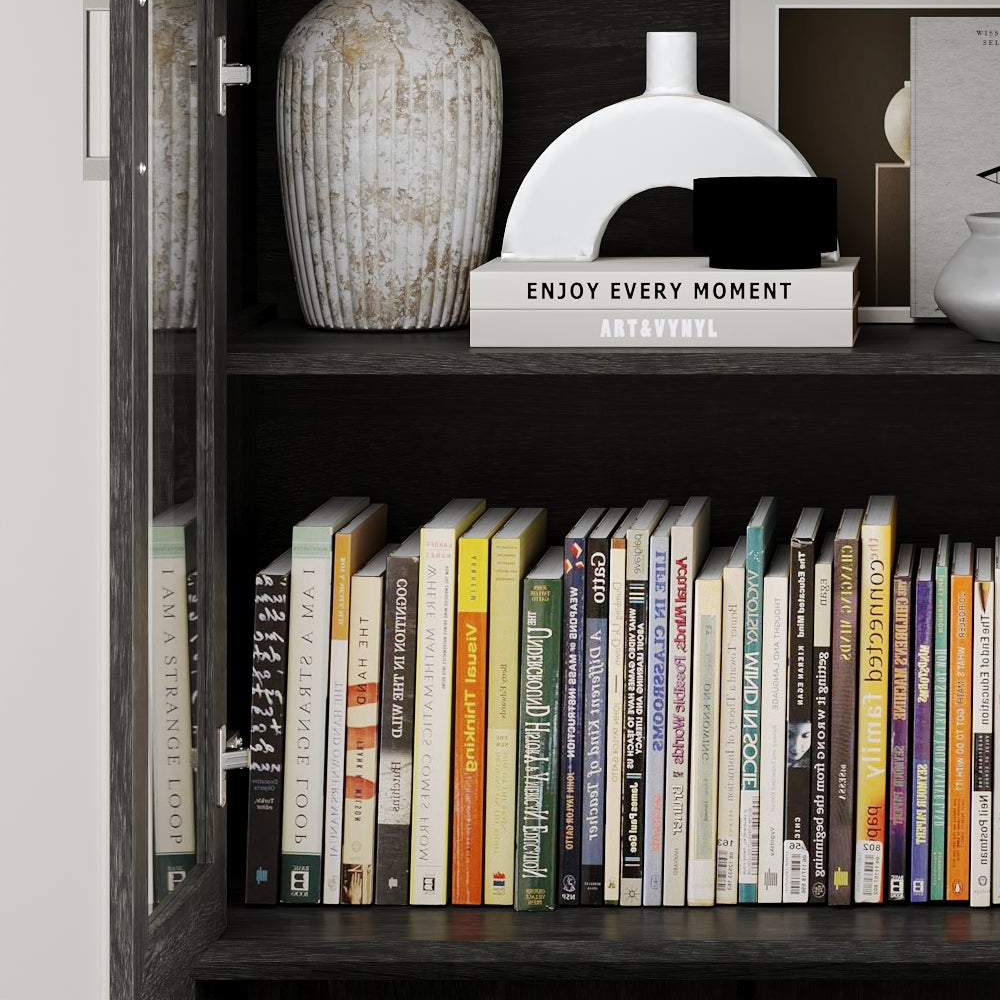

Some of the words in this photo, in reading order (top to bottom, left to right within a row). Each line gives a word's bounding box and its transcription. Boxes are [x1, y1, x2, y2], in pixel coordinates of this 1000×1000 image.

[526, 281, 600, 300] ENJOY
[610, 281, 682, 300] EVERY
[694, 281, 792, 300] MOMENT
[600, 318, 718, 338] ART&VYNYL
[164, 654, 181, 766] STRANGE
[168, 778, 184, 846] LOOP
